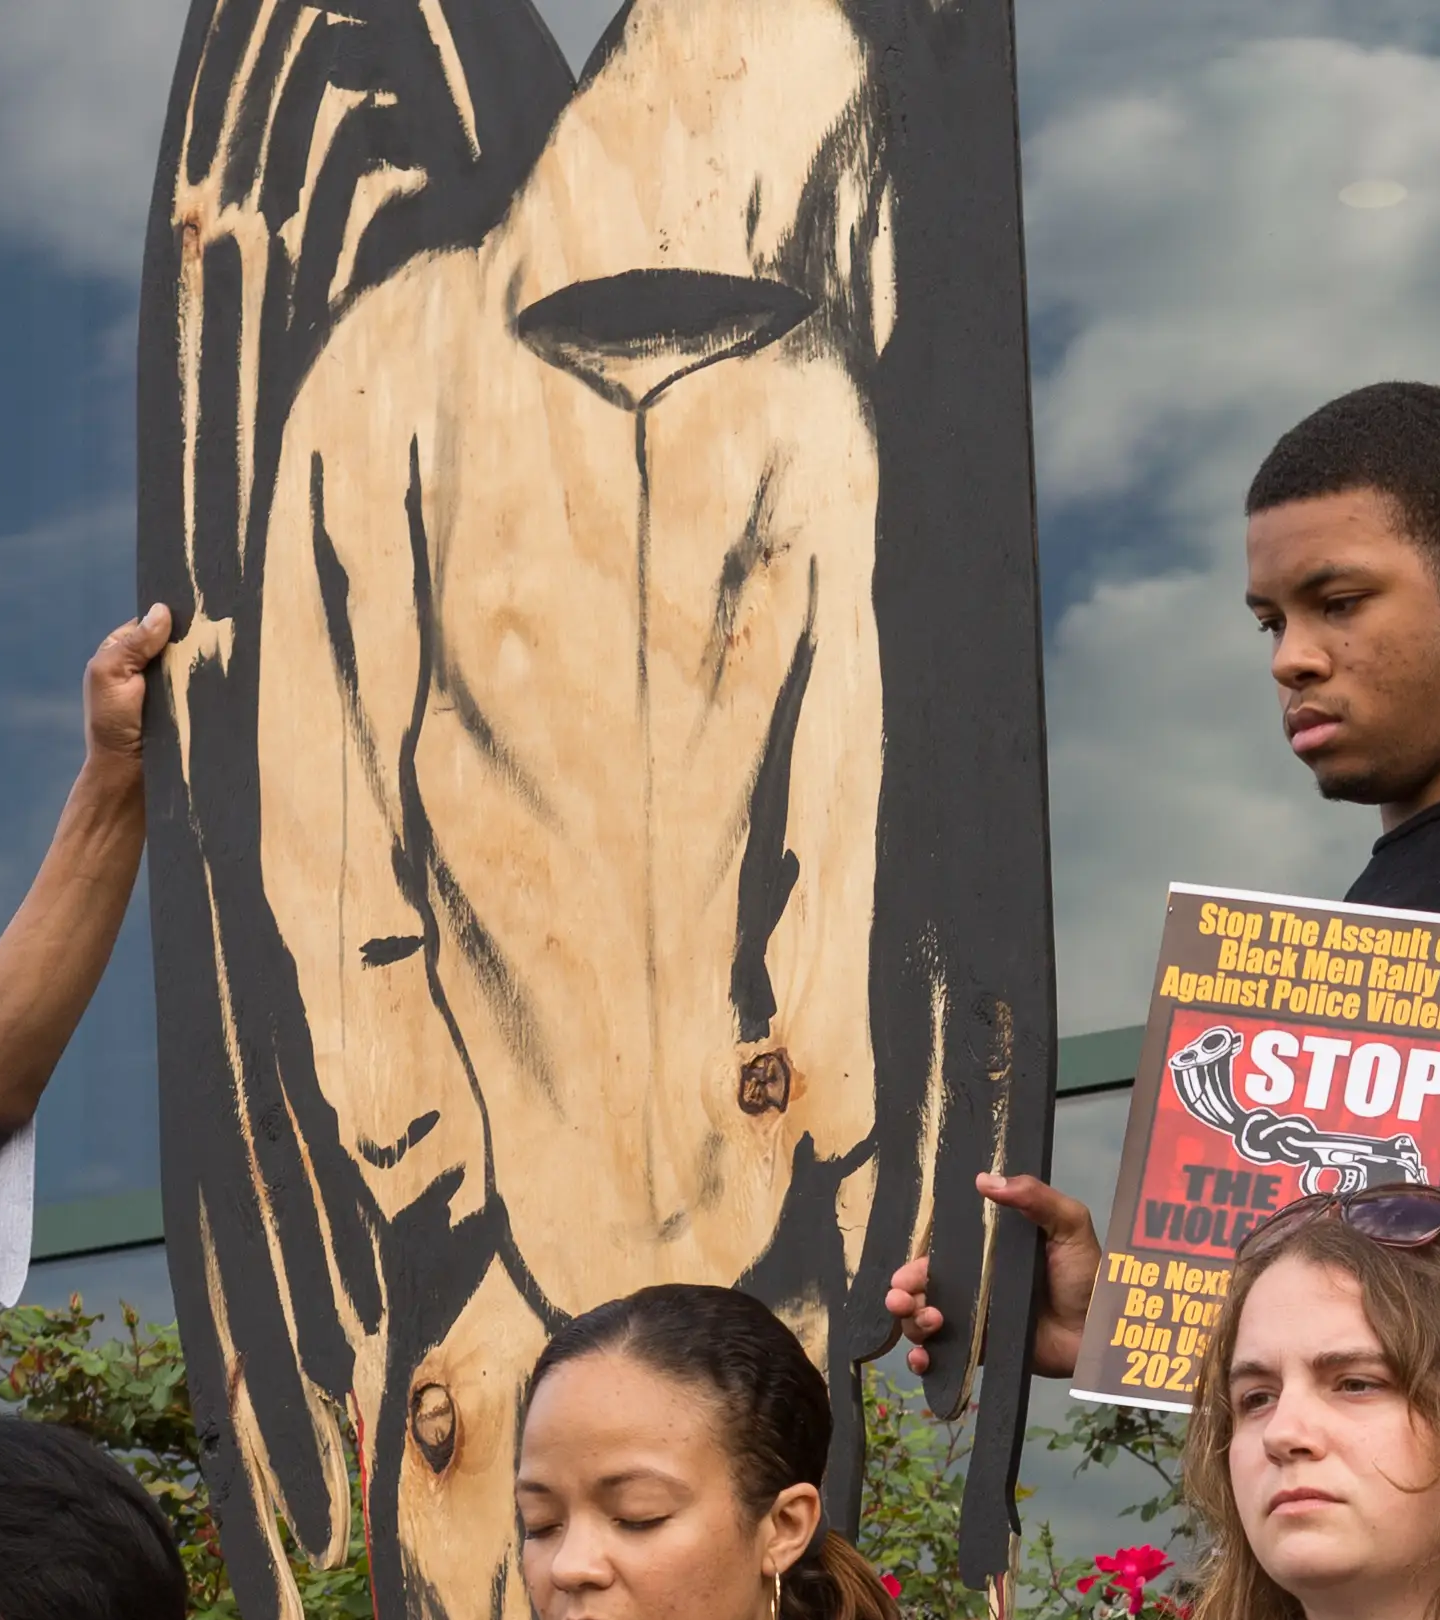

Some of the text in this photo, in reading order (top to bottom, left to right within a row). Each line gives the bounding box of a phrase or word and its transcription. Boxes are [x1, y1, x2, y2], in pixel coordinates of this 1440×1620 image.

[1198, 902, 1263, 942] Stop
[1269, 911, 1320, 948] The
[1322, 918, 1431, 960] Assault
[1218, 939, 1440, 998] Black Men Rally
[1160, 965, 1269, 1009] Against
[1271, 980, 1361, 1020] Police
[1182, 1164, 1282, 1211] THE
[1144, 1199, 1268, 1249] VIOLE
[1107, 1252, 1231, 1297] The Next
[1123, 1287, 1222, 1327] Be You
[1110, 1318, 1172, 1353] Join
[1121, 1350, 1200, 1392] 202.
